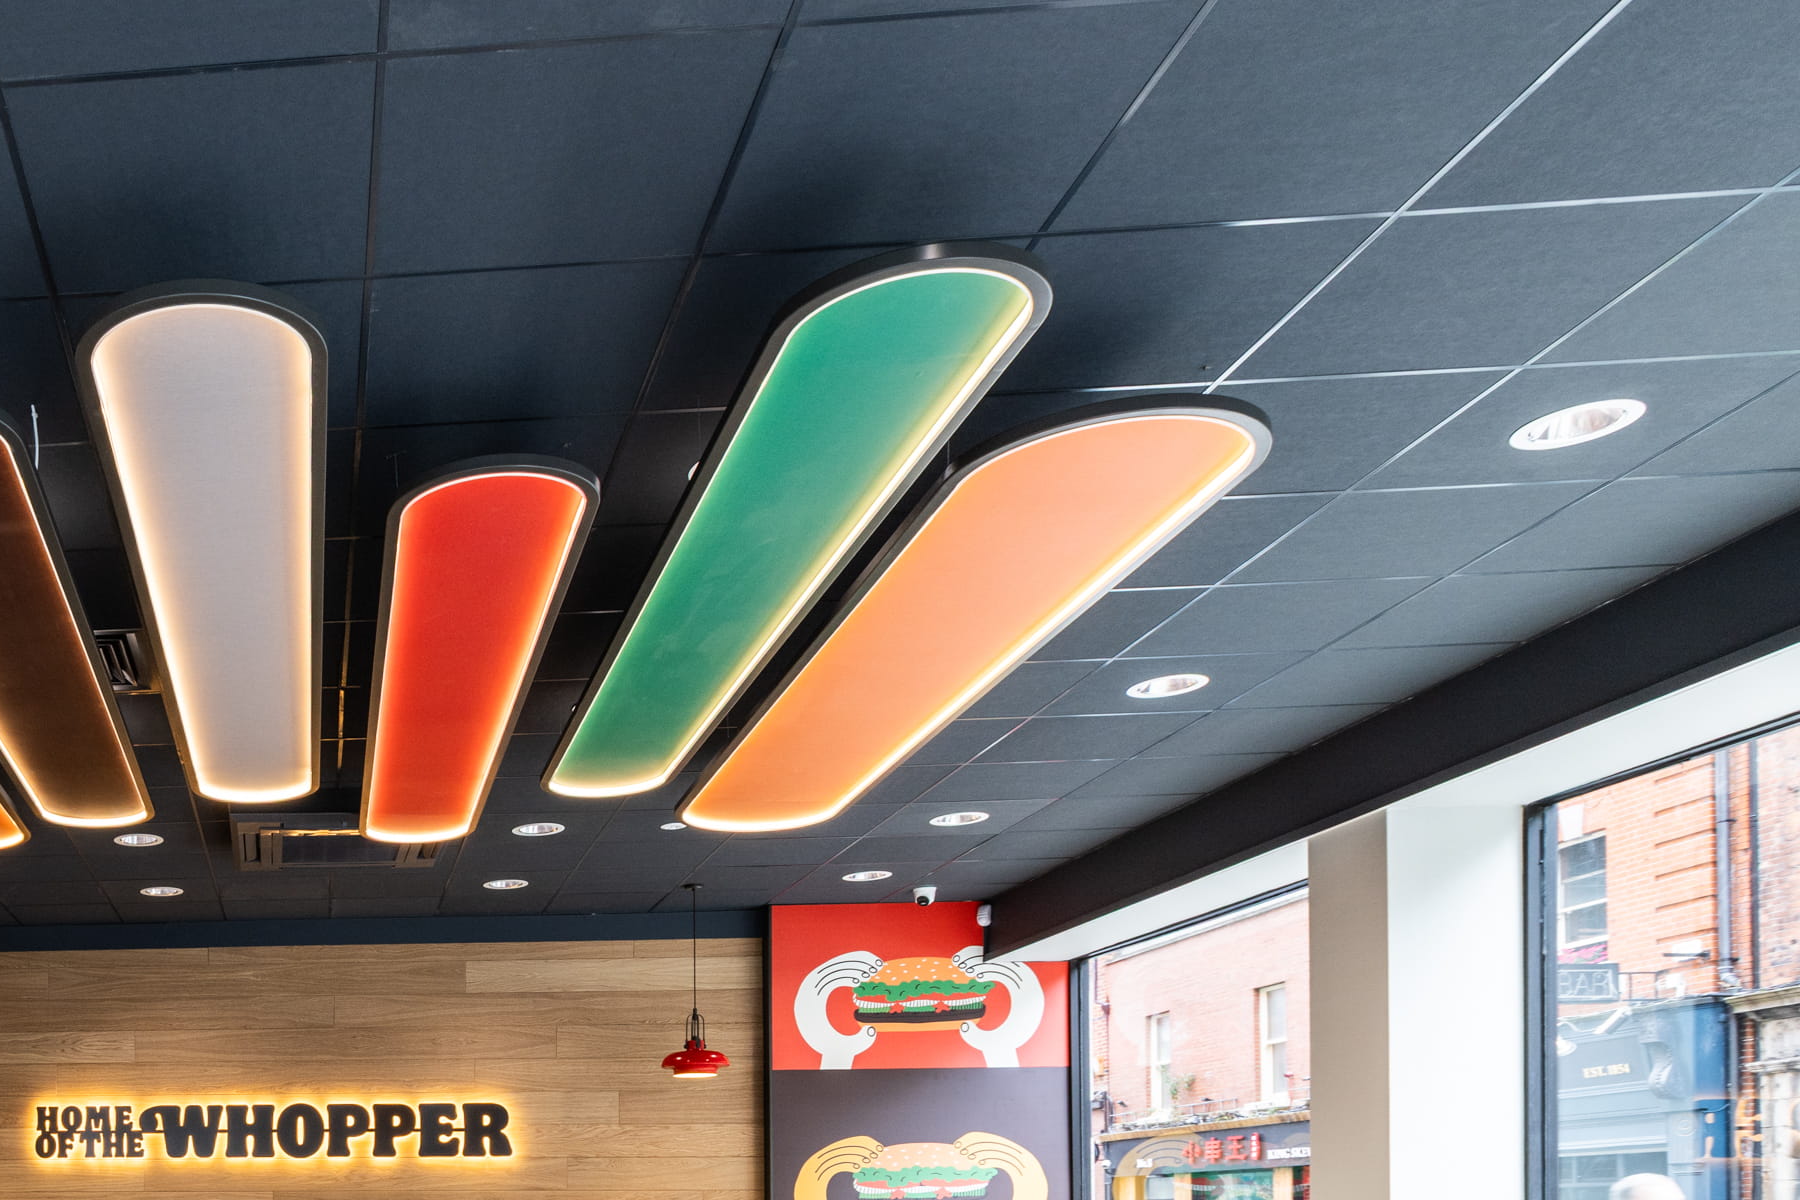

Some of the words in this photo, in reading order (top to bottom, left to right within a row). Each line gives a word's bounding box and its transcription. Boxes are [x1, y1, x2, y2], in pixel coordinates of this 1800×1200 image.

[1558, 971, 1608, 996] BAR
[36, 1105, 133, 1132] HOME
[139, 1103, 512, 1158] WHOPPER
[35, 1130, 75, 1158] OF
[79, 1131, 144, 1158] THE
